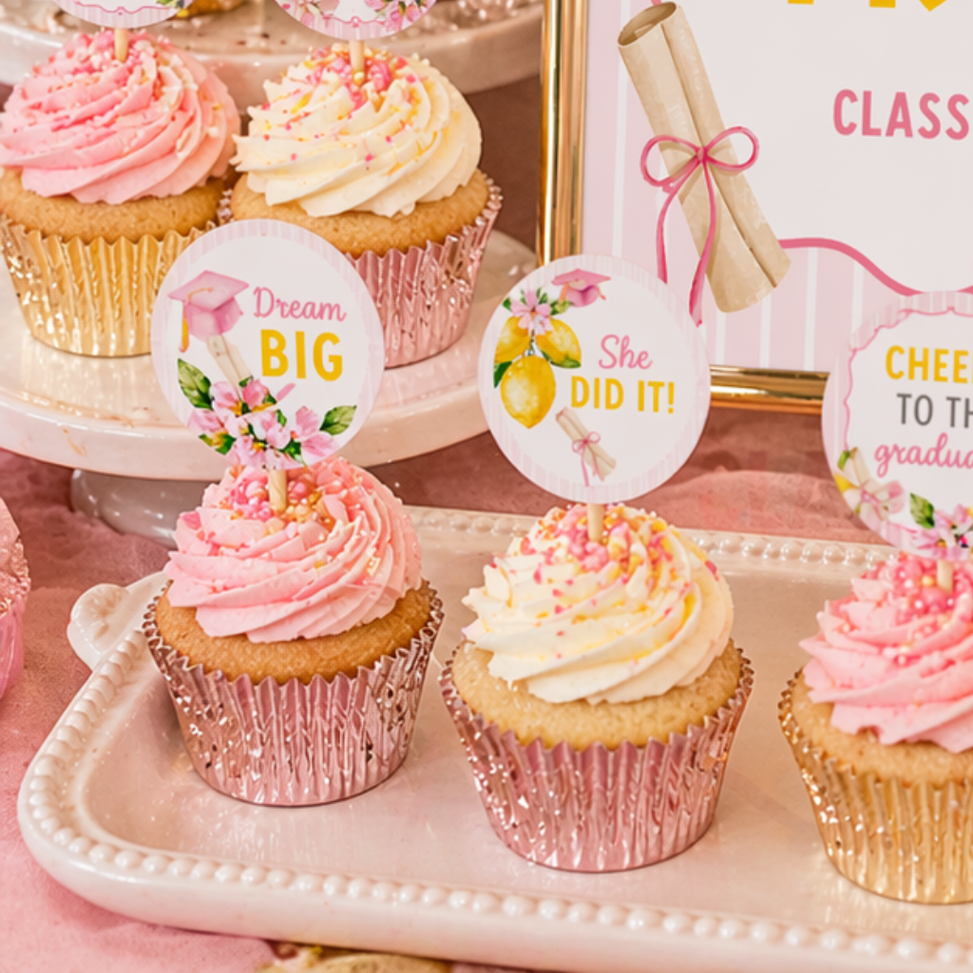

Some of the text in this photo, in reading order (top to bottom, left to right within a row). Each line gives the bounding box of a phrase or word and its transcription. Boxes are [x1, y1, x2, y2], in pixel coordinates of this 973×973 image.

[833, 89, 969, 140] CLASS
[253, 287, 346, 321] Dream
[259, 329, 344, 382] BIG
[599, 335, 652, 369] She
[571, 375, 675, 414] DID IT!
[897, 393, 933, 426] TO
